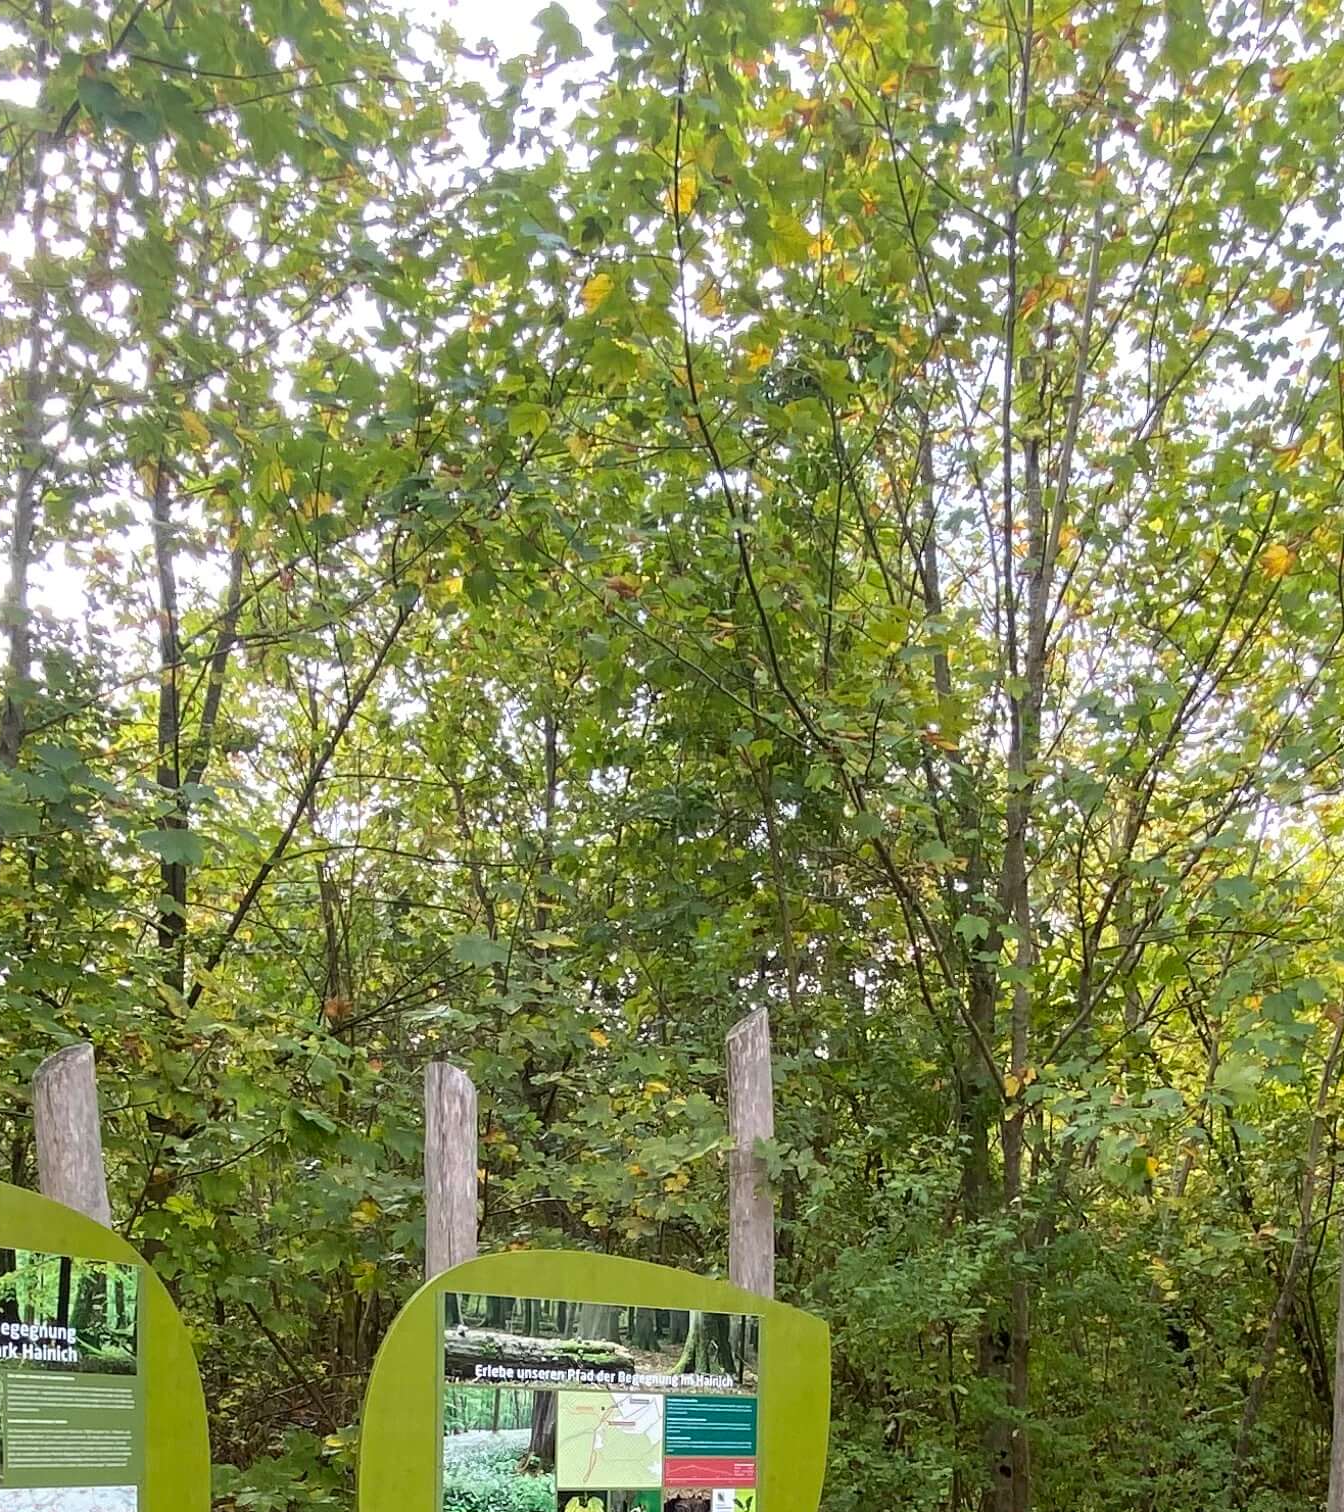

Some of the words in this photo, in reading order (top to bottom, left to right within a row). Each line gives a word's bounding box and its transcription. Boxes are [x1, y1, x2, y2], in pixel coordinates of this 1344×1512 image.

[21, 1343, 78, 1362] Hainich
[474, 1364, 514, 1378] Erlebe
[517, 1368, 565, 1380] unseren
[567, 1368, 594, 1382] Pfad
[596, 1369, 615, 1383] der
[618, 1371, 678, 1387] Begegnung
[696, 1373, 733, 1387] Hainich
